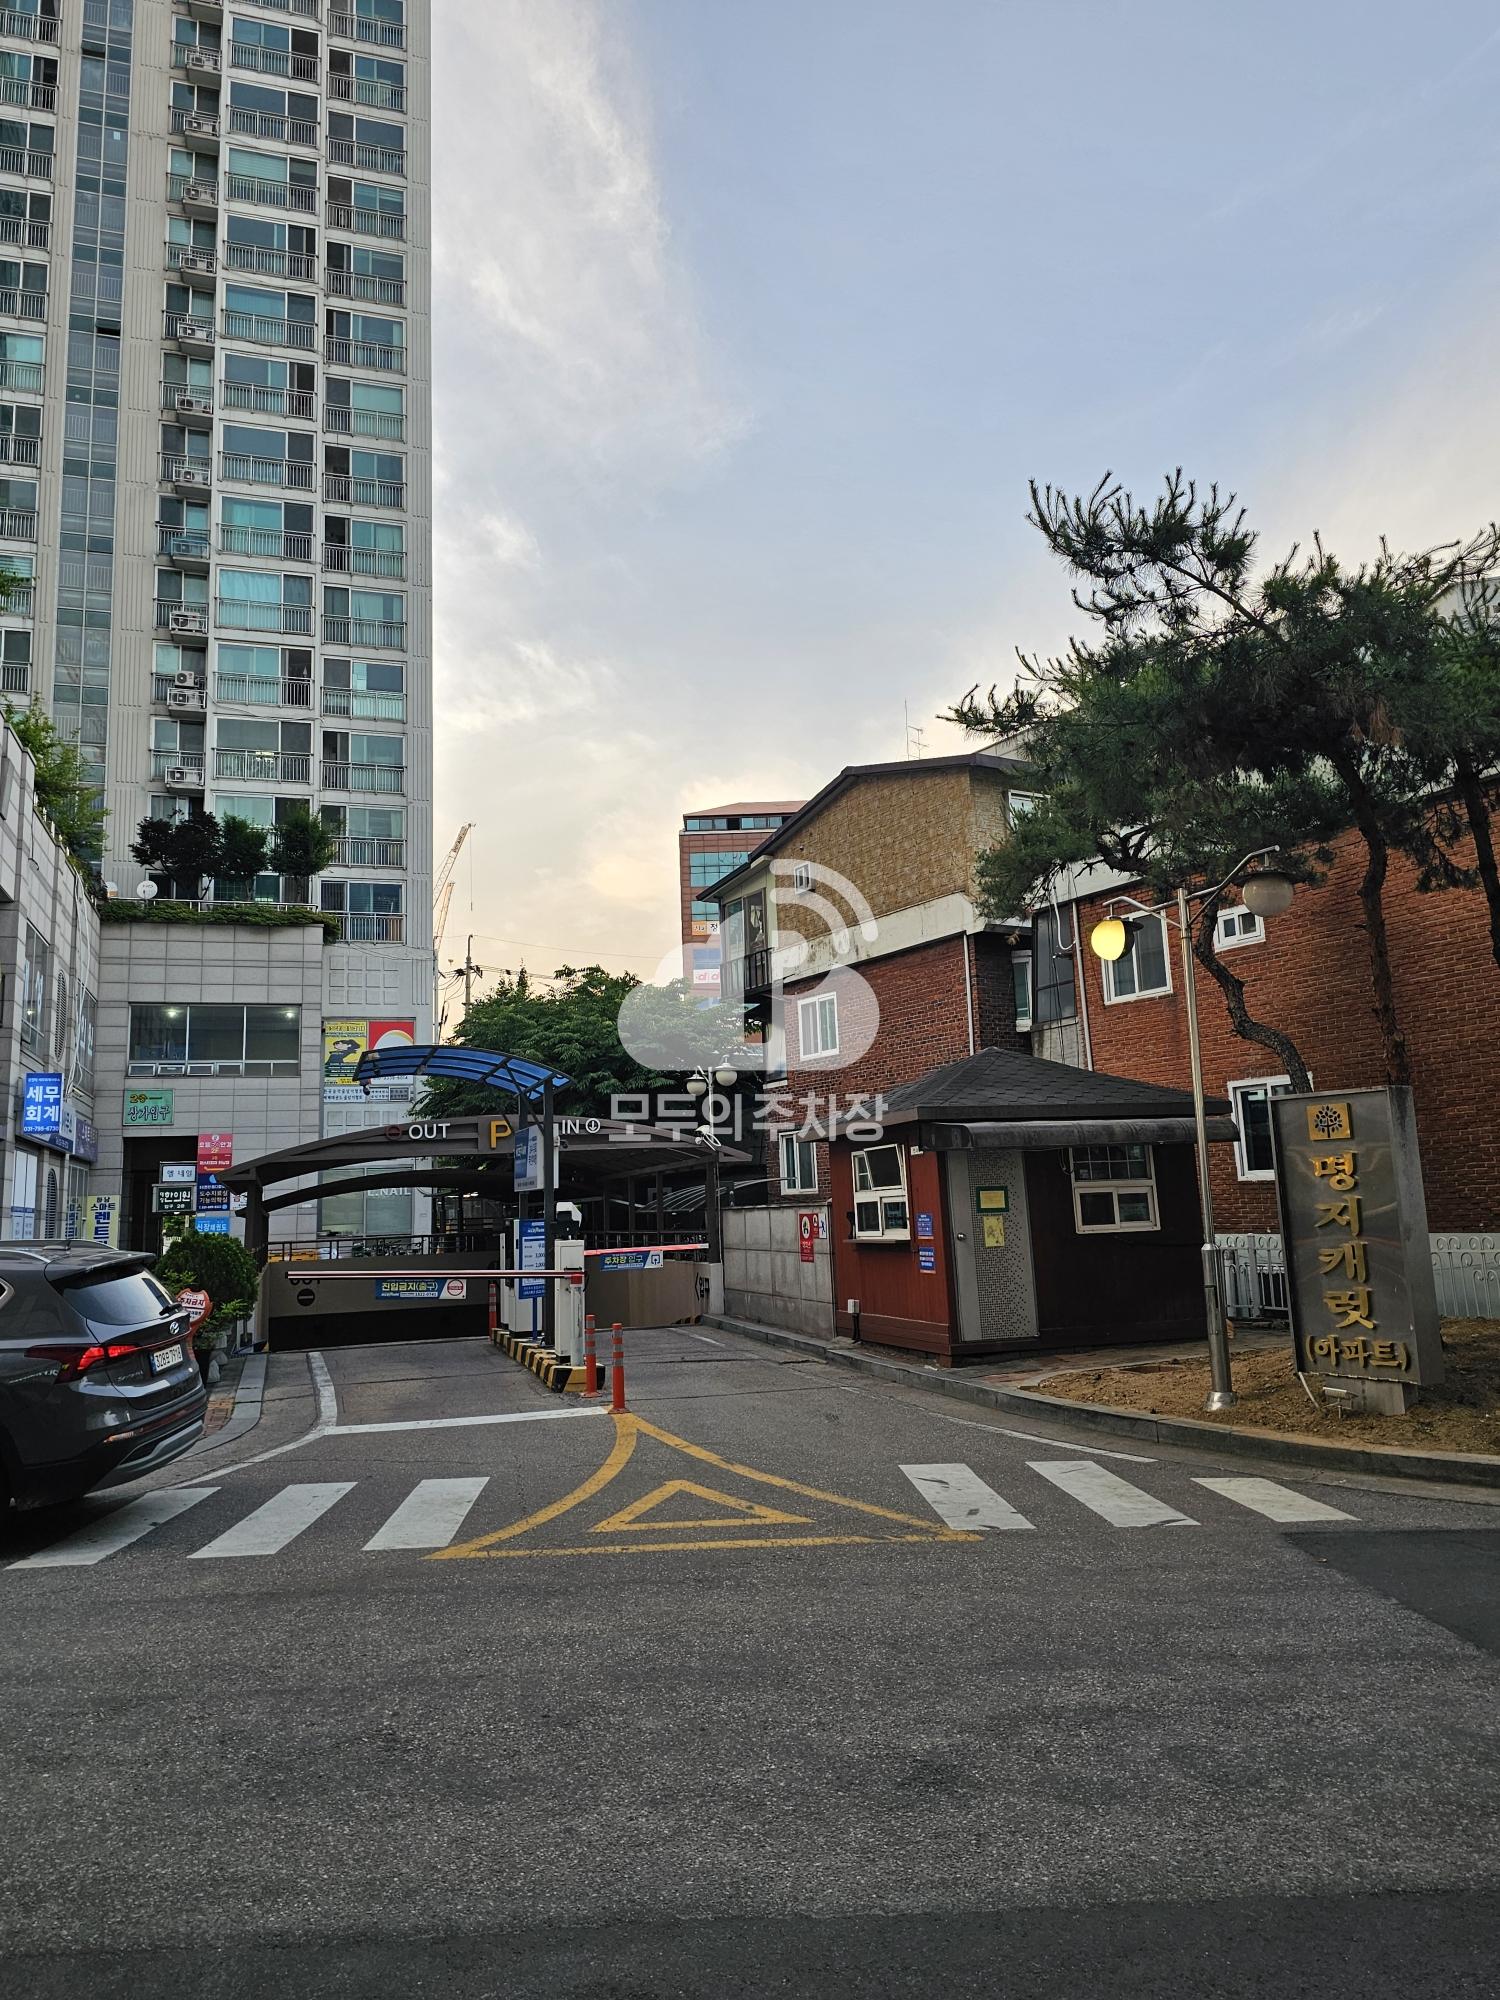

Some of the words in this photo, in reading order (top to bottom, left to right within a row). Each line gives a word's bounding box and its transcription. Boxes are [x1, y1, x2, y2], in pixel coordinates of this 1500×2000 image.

[26, 1085, 61, 1103] 세무
[25, 1105, 60, 1122] 회계
[127, 1104, 171, 1121] 상가입구
[408, 1123, 451, 1140] OUT
[490, 1120, 512, 1149] P
[562, 1119, 580, 1135] IN
[90, 1202, 116, 1211] 스마트
[604, 1256, 627, 1265] 주차장
[628, 1254, 643, 1263] 입구
[381, 1281, 438, 1292] 진입금지(출구)
[1304, 1334, 1410, 1372] (아파트)
